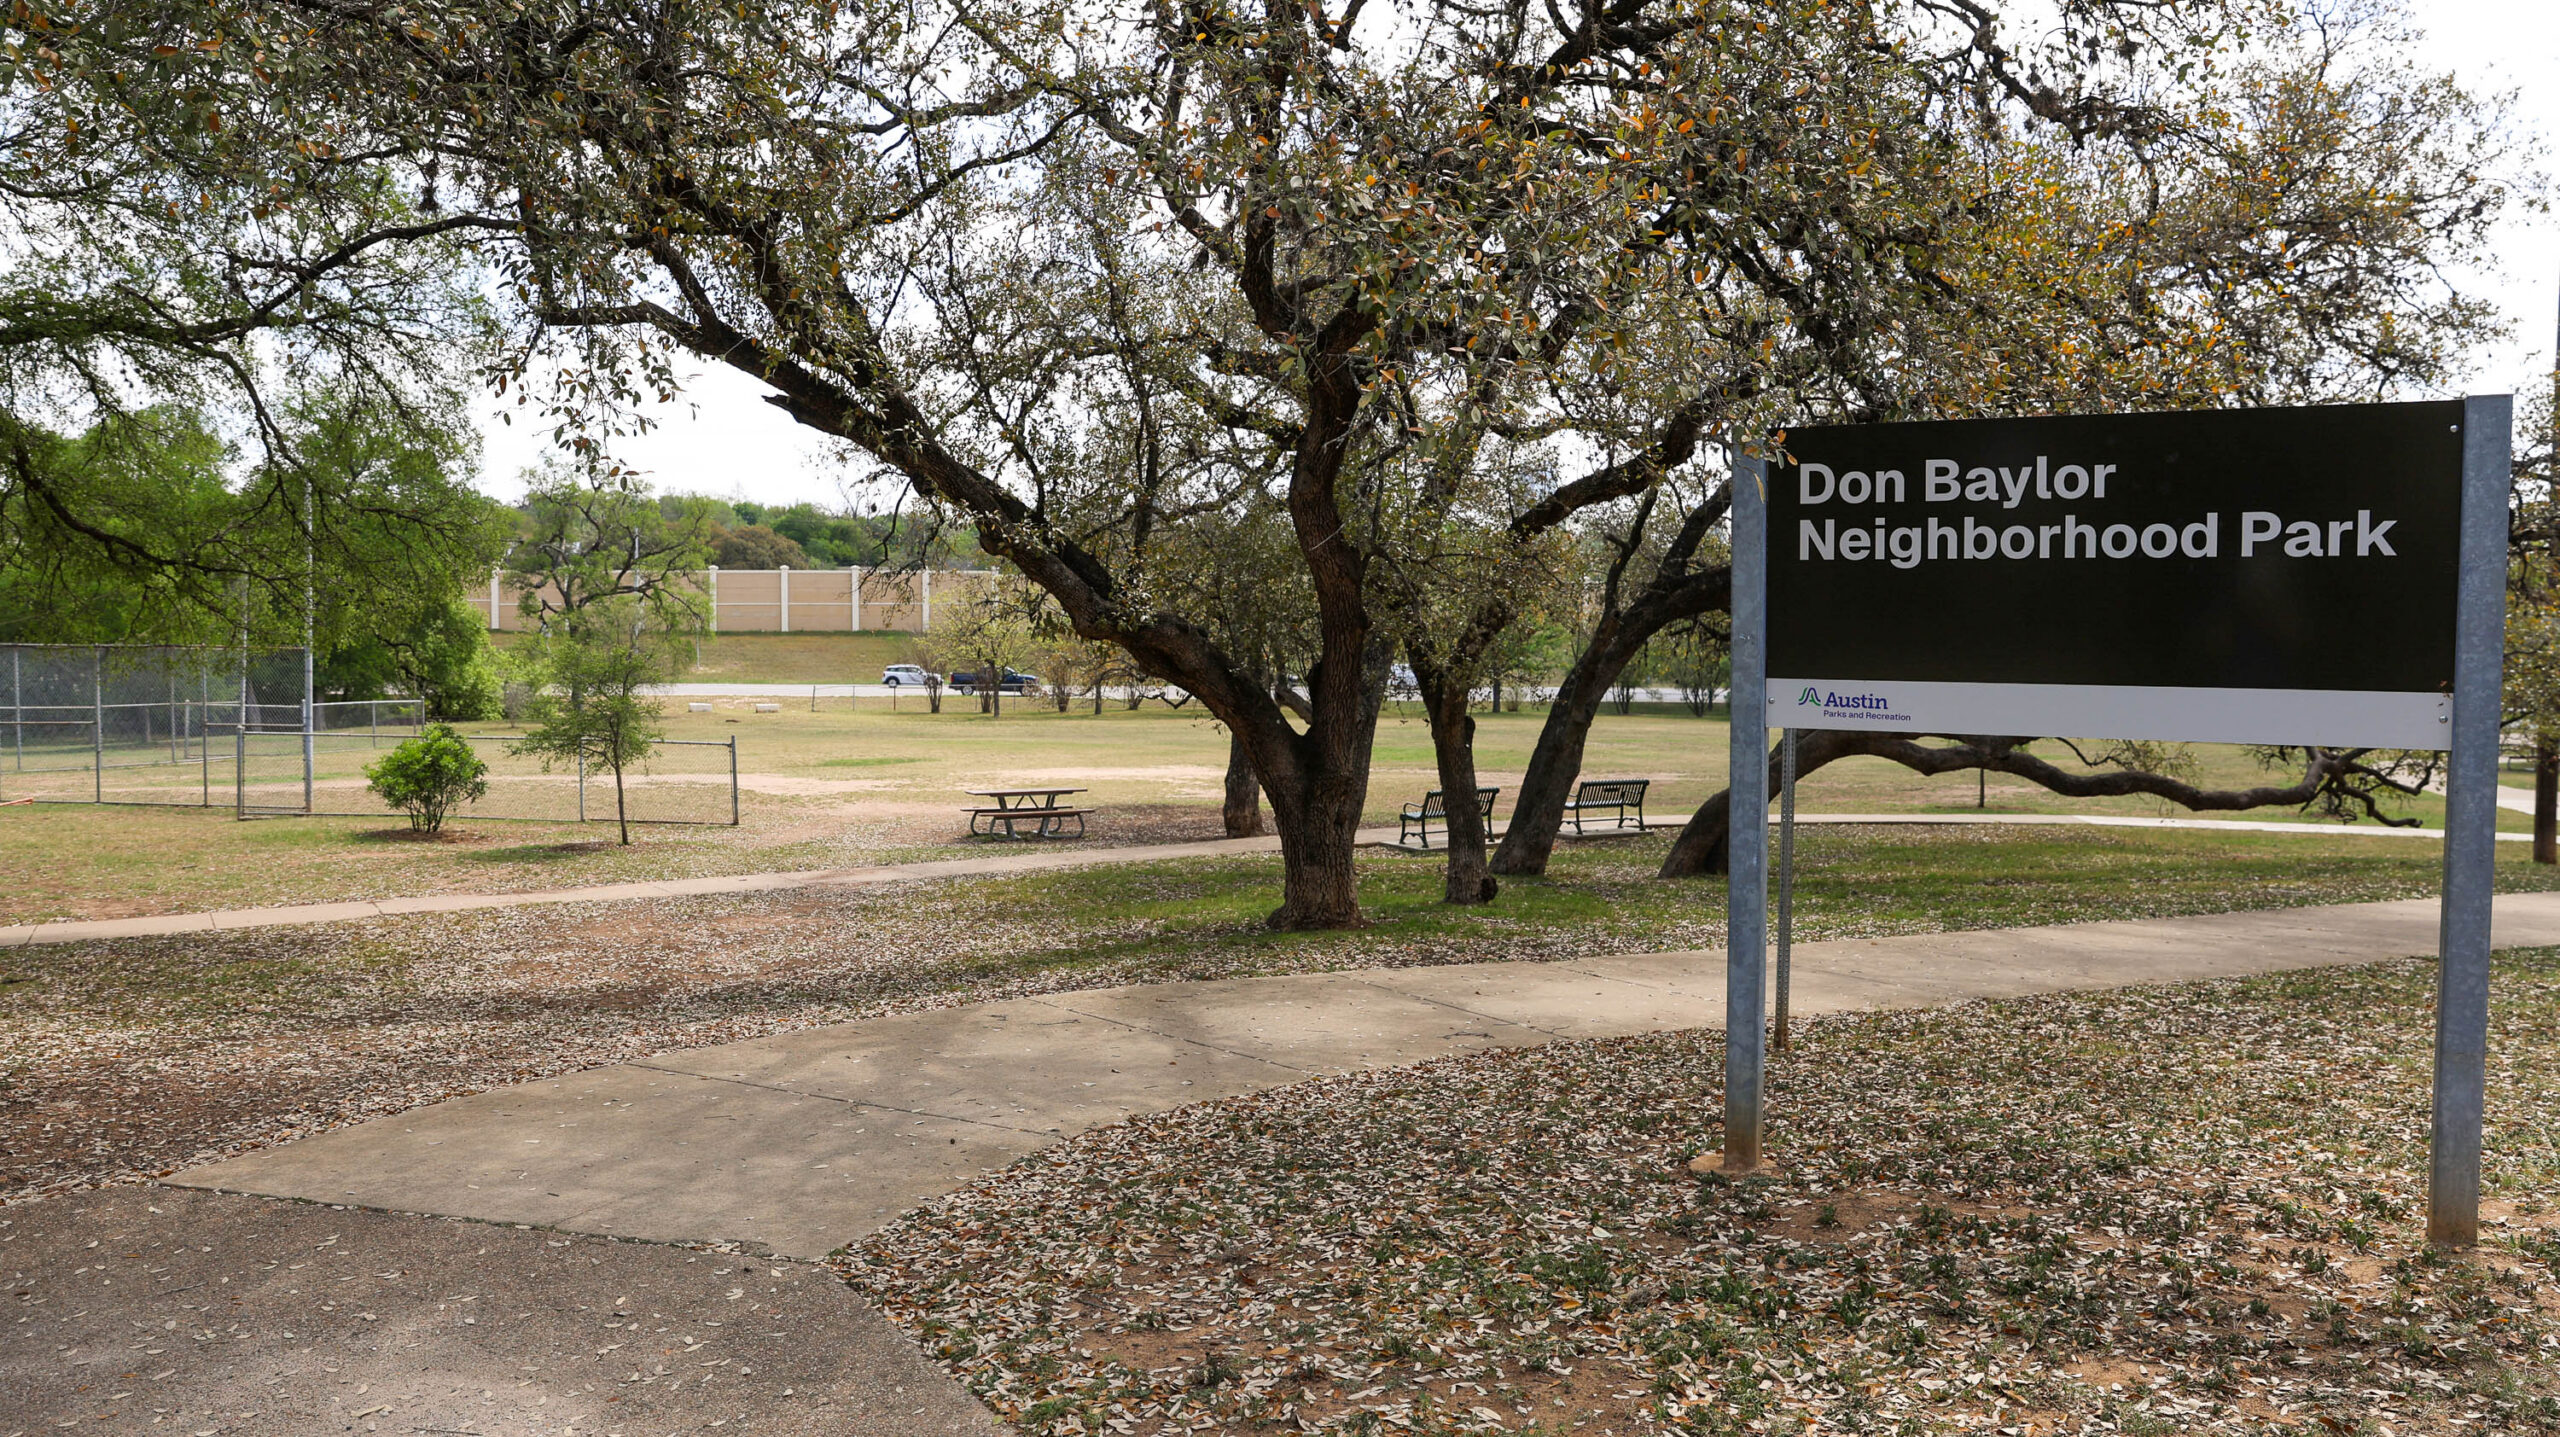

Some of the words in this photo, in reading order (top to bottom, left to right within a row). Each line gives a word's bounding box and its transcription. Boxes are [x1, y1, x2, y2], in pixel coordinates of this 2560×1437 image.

[1799, 463, 1905, 505] Don
[1925, 456, 2117, 509] Baylor
[1799, 513, 2219, 569] Neighborhood
[2240, 509, 2398, 558] Park
[1823, 710, 1847, 718] Parks
[1848, 711, 1864, 719] and
[1865, 711, 1911, 721] Recreation
[1824, 692, 1888, 709] Austin
